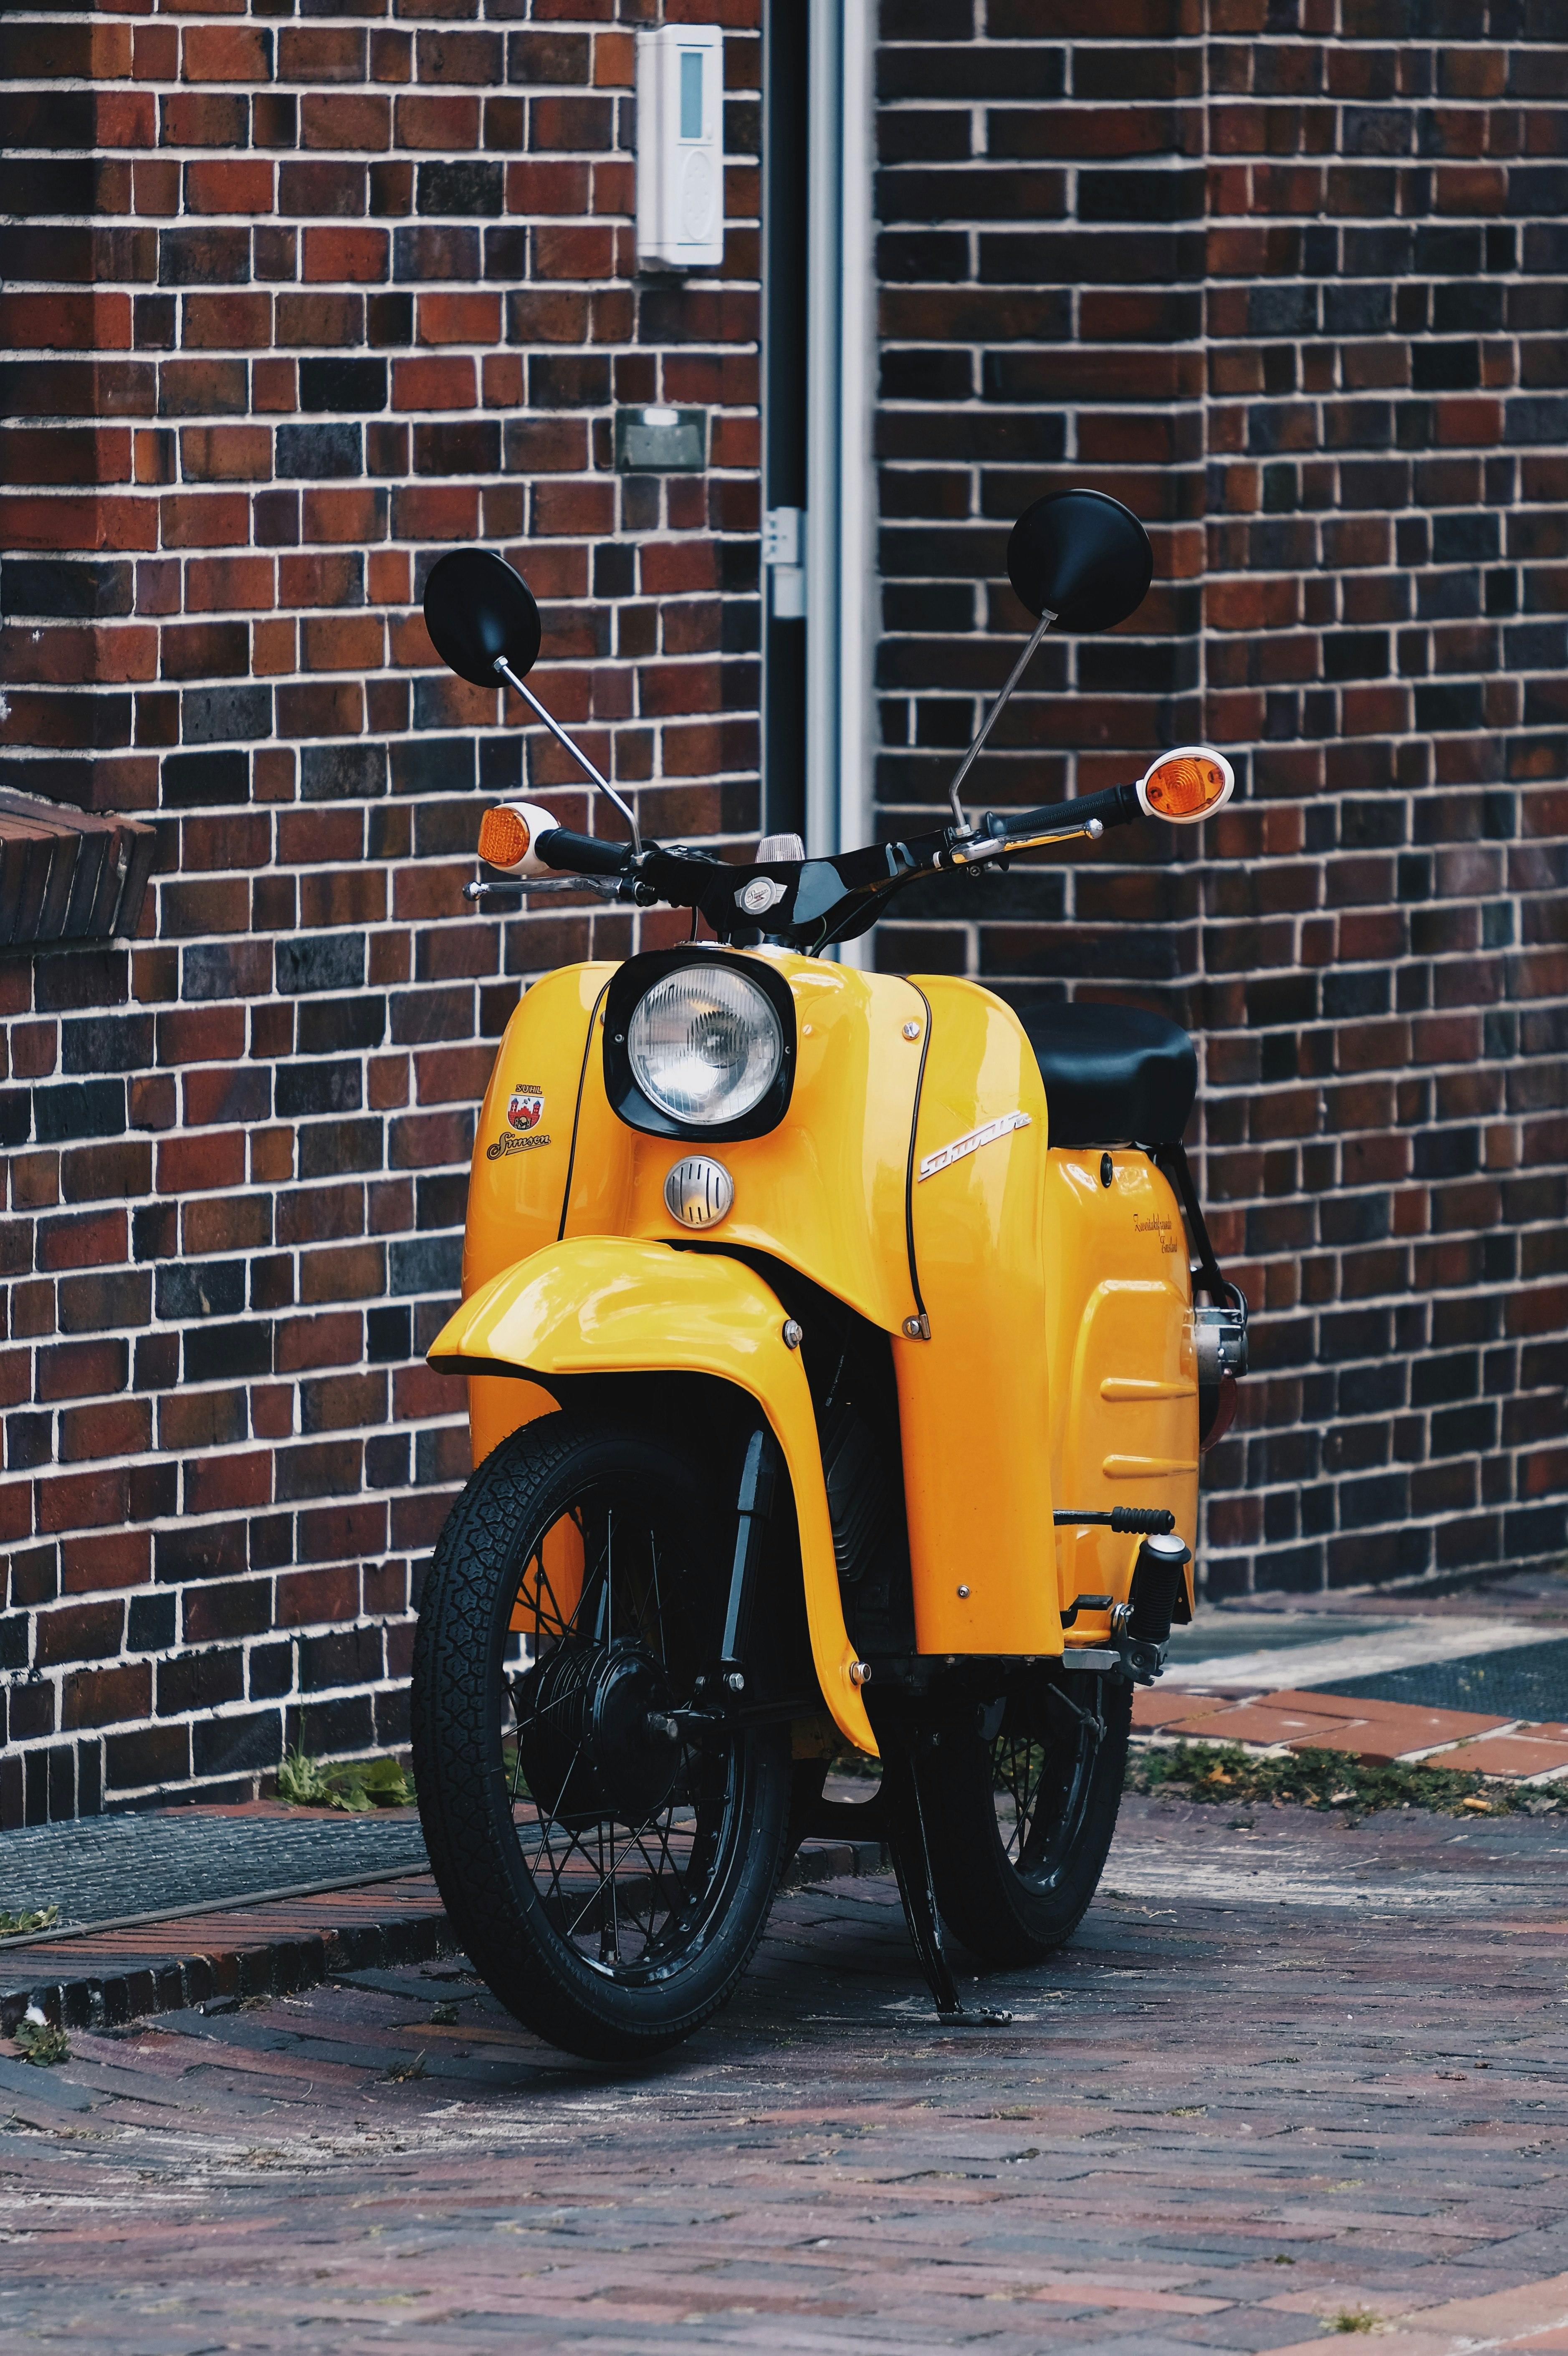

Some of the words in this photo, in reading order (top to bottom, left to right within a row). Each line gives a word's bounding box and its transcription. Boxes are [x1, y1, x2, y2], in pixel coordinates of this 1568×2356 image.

[516, 1084, 542, 1094] SUHL
[487, 1132, 551, 1160] Simson
[918, 1110, 1032, 1182] Schwalbe
